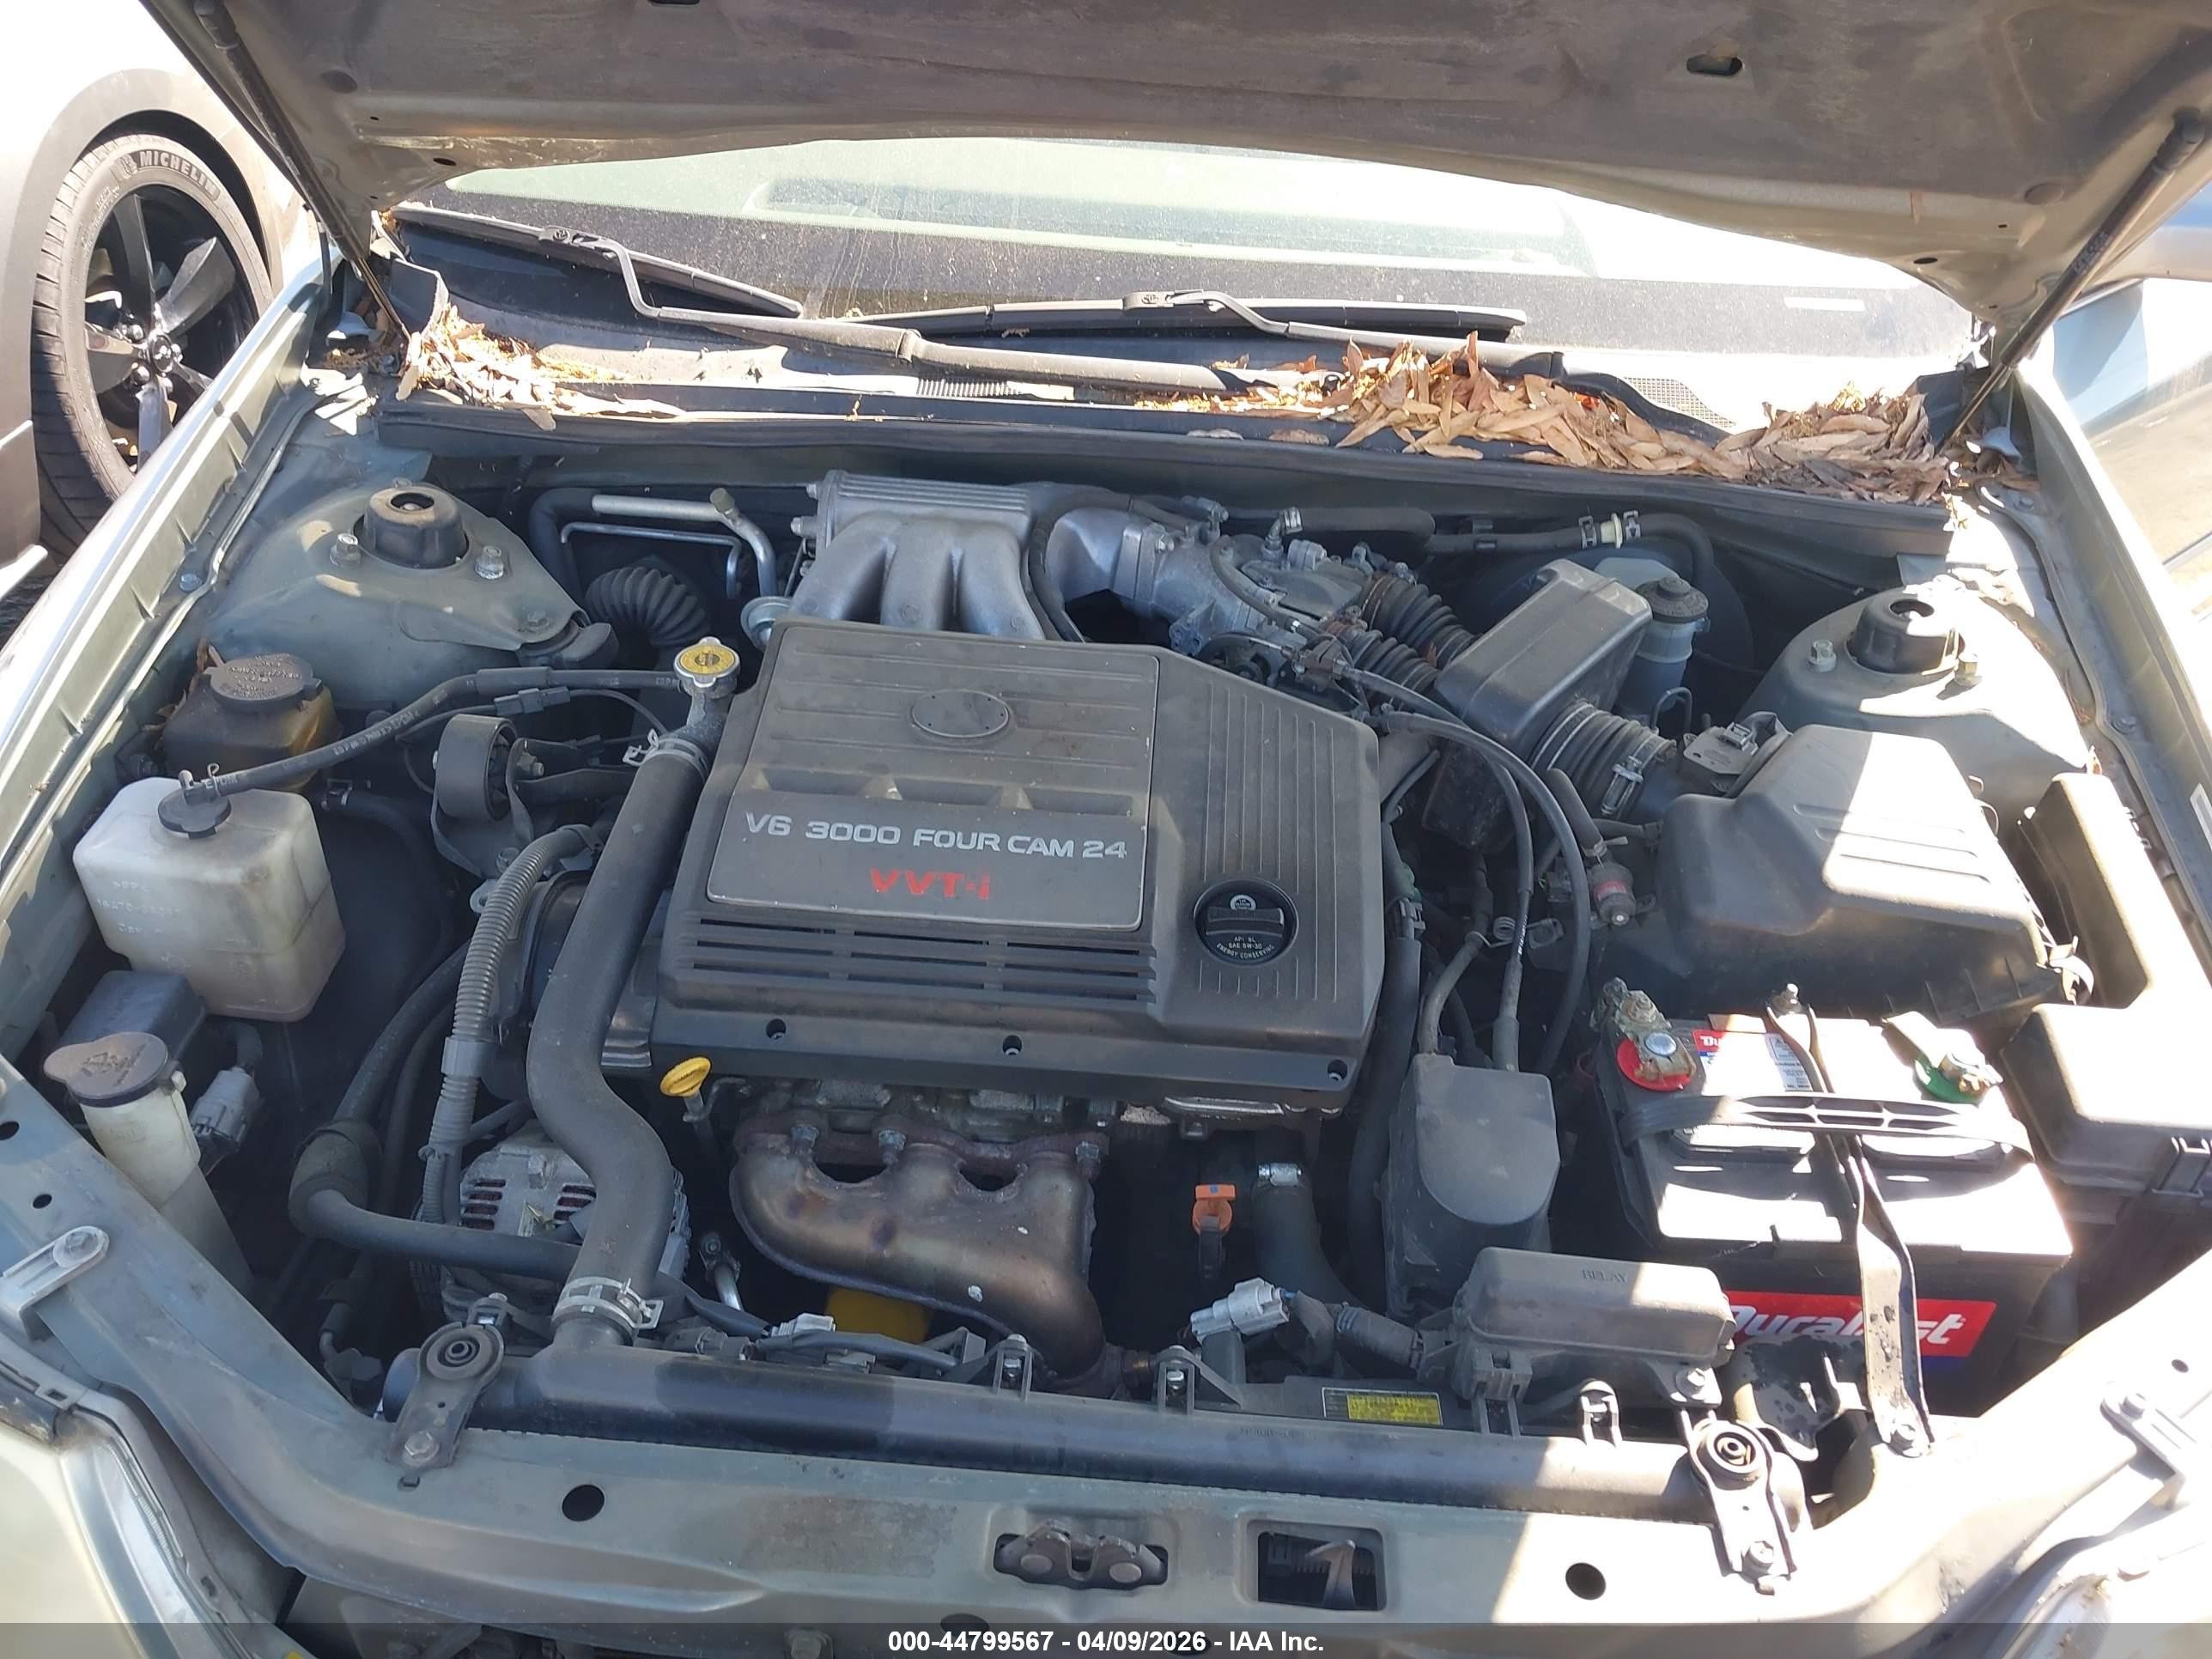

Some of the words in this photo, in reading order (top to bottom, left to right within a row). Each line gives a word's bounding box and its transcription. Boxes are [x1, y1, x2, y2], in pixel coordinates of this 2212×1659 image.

[139, 150, 219, 198] MICHELIN
[745, 811, 793, 836] V6
[805, 821, 902, 845] 3000
[913, 828, 1001, 852] FOUR
[1007, 835, 1075, 859] CAM
[1082, 840, 1127, 860] 24
[1582, 1269, 1629, 1284] RELAY
